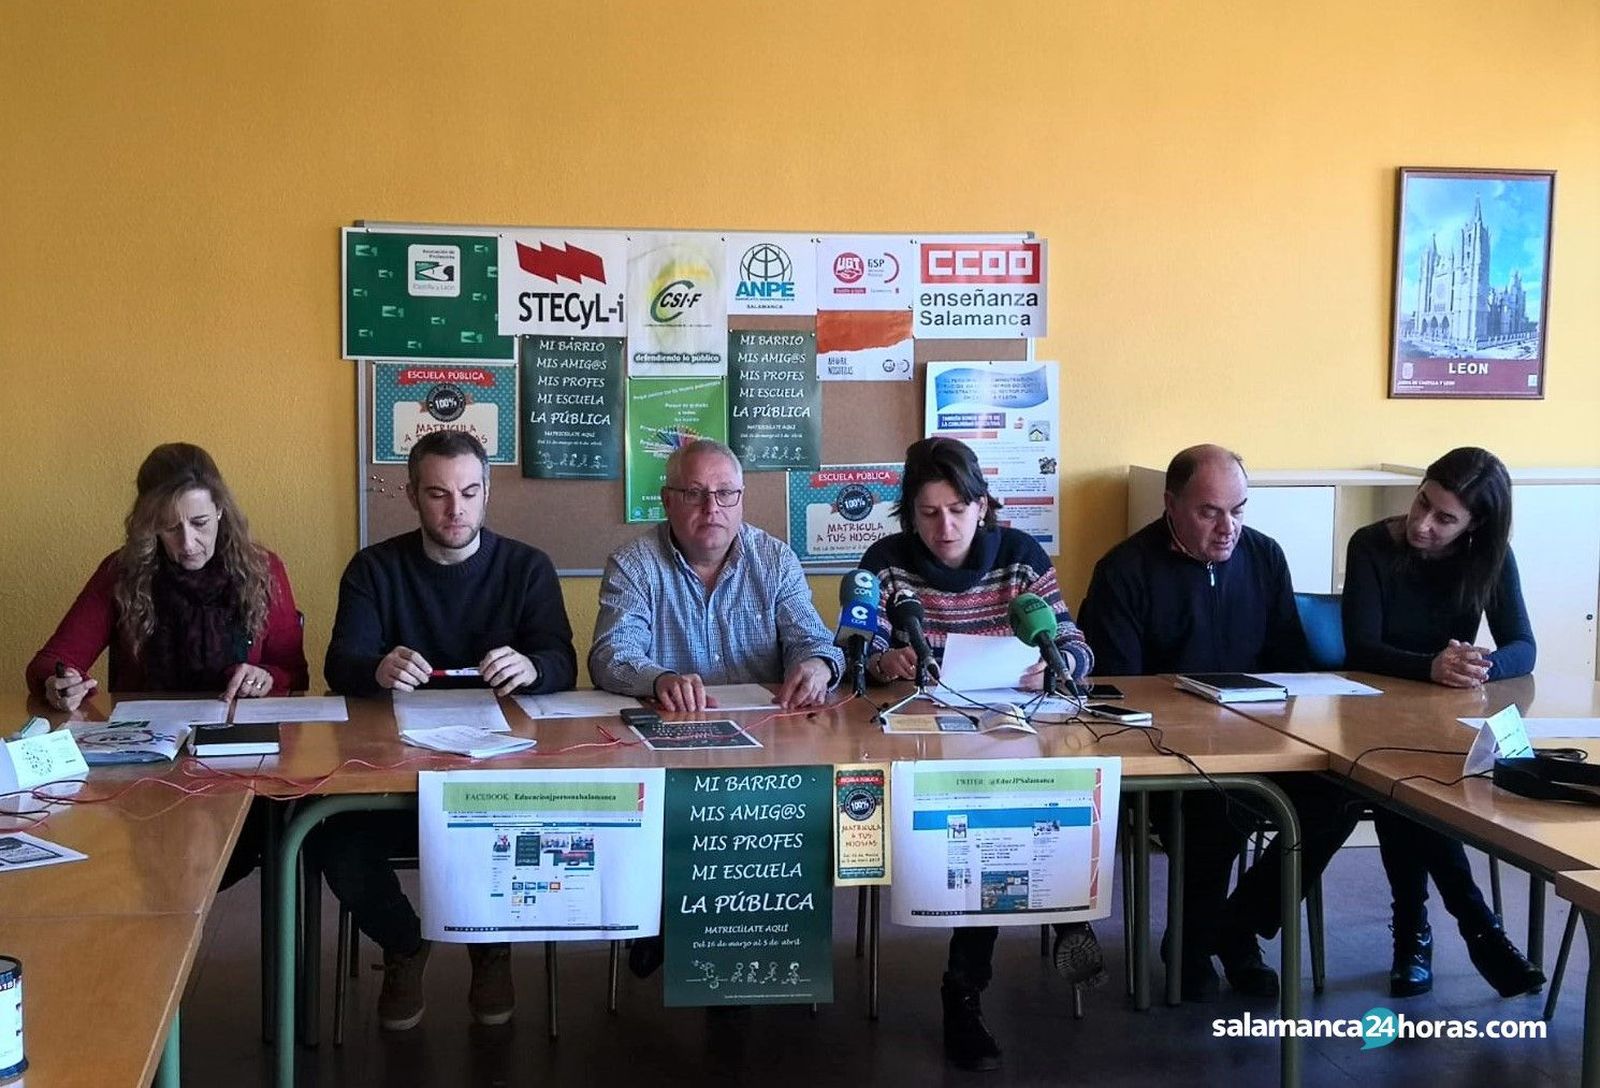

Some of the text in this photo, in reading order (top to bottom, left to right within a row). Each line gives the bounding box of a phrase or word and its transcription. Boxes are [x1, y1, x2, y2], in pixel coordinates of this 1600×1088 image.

[929, 251, 1033, 276] CCOO
[735, 281, 796, 297] ANPE
[919, 288, 1039, 307] enseñanza
[518, 291, 625, 331] STECyL-i
[919, 310, 1032, 326] Salamanca
[539, 339, 606, 352] MI BARRIO
[740, 334, 805, 346] MI BARRIO
[536, 357, 607, 371] MIS AMIG@S
[737, 352, 759, 363] MIS
[407, 370, 446, 380] ESCUELA
[1448, 362, 1489, 375] LEON
[538, 375, 606, 389] MIS PROFES
[740, 370, 805, 381] MIS PROFES
[537, 392, 605, 406] MI ESCUELA
[740, 387, 805, 399] MI ESCUELA
[435, 398, 458, 410] 100%
[733, 404, 811, 418] LA PÚBLICA
[530, 410, 611, 426] LA PÚBLICA
[818, 473, 855, 481] ESCUELA
[845, 498, 867, 509] 100%
[827, 522, 884, 534] MATRICULA
[816, 532, 886, 543] A TUS HIJOS/
[694, 774, 802, 792] MI BARRIO
[465, 793, 509, 801] FACEBOOK
[851, 800, 869, 811] 100%
[690, 803, 807, 822] MIS AMIG@S
[692, 833, 804, 851] MIS PROFES
[691, 862, 802, 881] MI ESCUELA
[680, 891, 814, 914] LA PÚBLICA
[704, 923, 790, 934] MATRICÚLATE AQUÍ
[727, 940, 752, 949] marzo
[780, 938, 801, 946] abril
